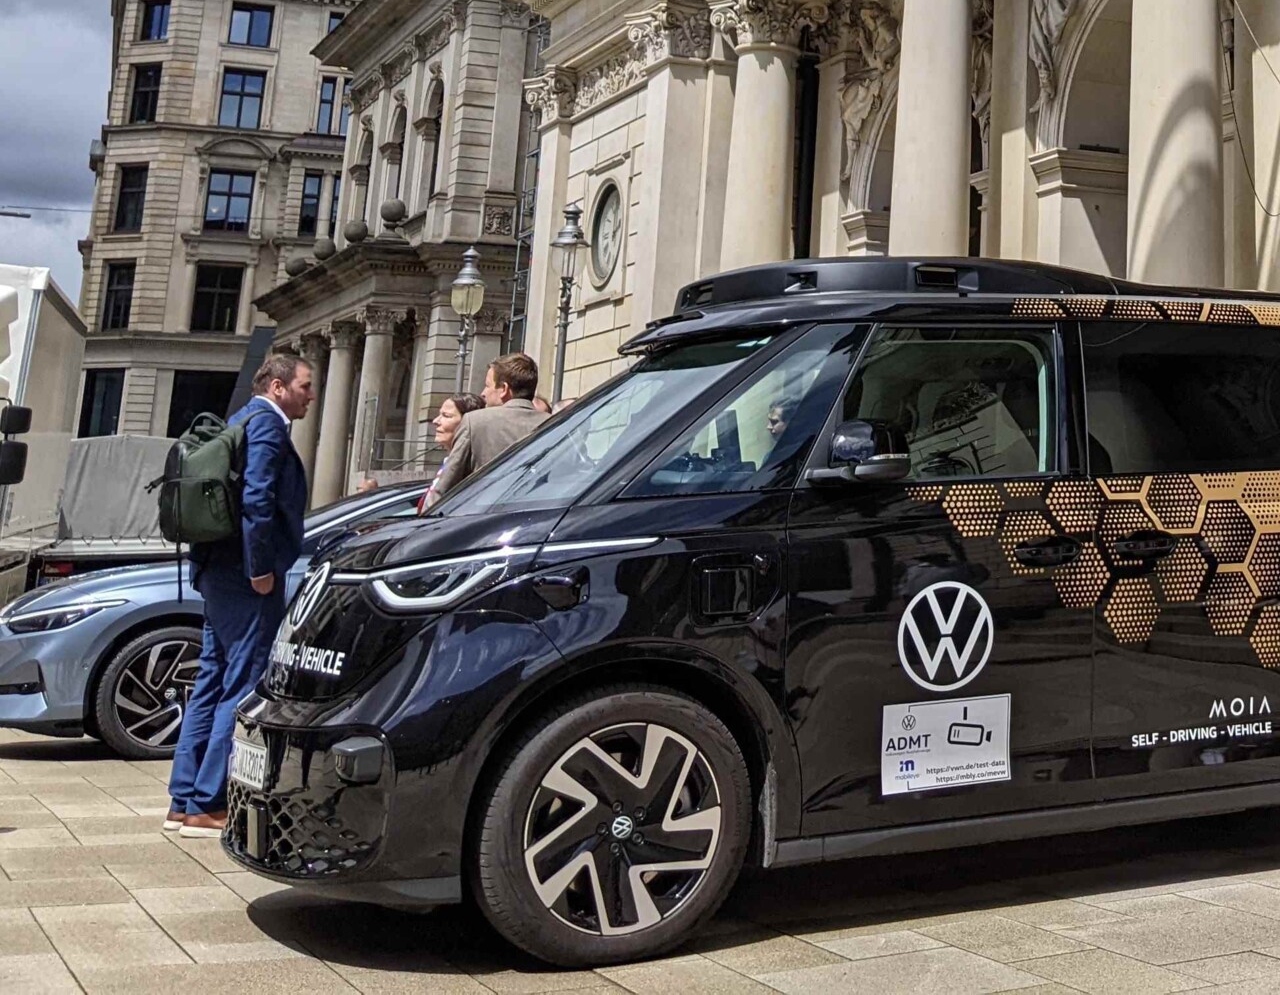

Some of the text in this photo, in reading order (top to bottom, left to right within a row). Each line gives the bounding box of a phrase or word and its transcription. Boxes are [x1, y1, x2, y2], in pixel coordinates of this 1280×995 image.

[300, 645, 345, 676] VEHICLE
[885, 734, 932, 752] ADMT
[1131, 732, 1159, 747] SELF
[1169, 726, 1217, 743] DRIVING
[1227, 721, 1273, 737] VEHICLE
